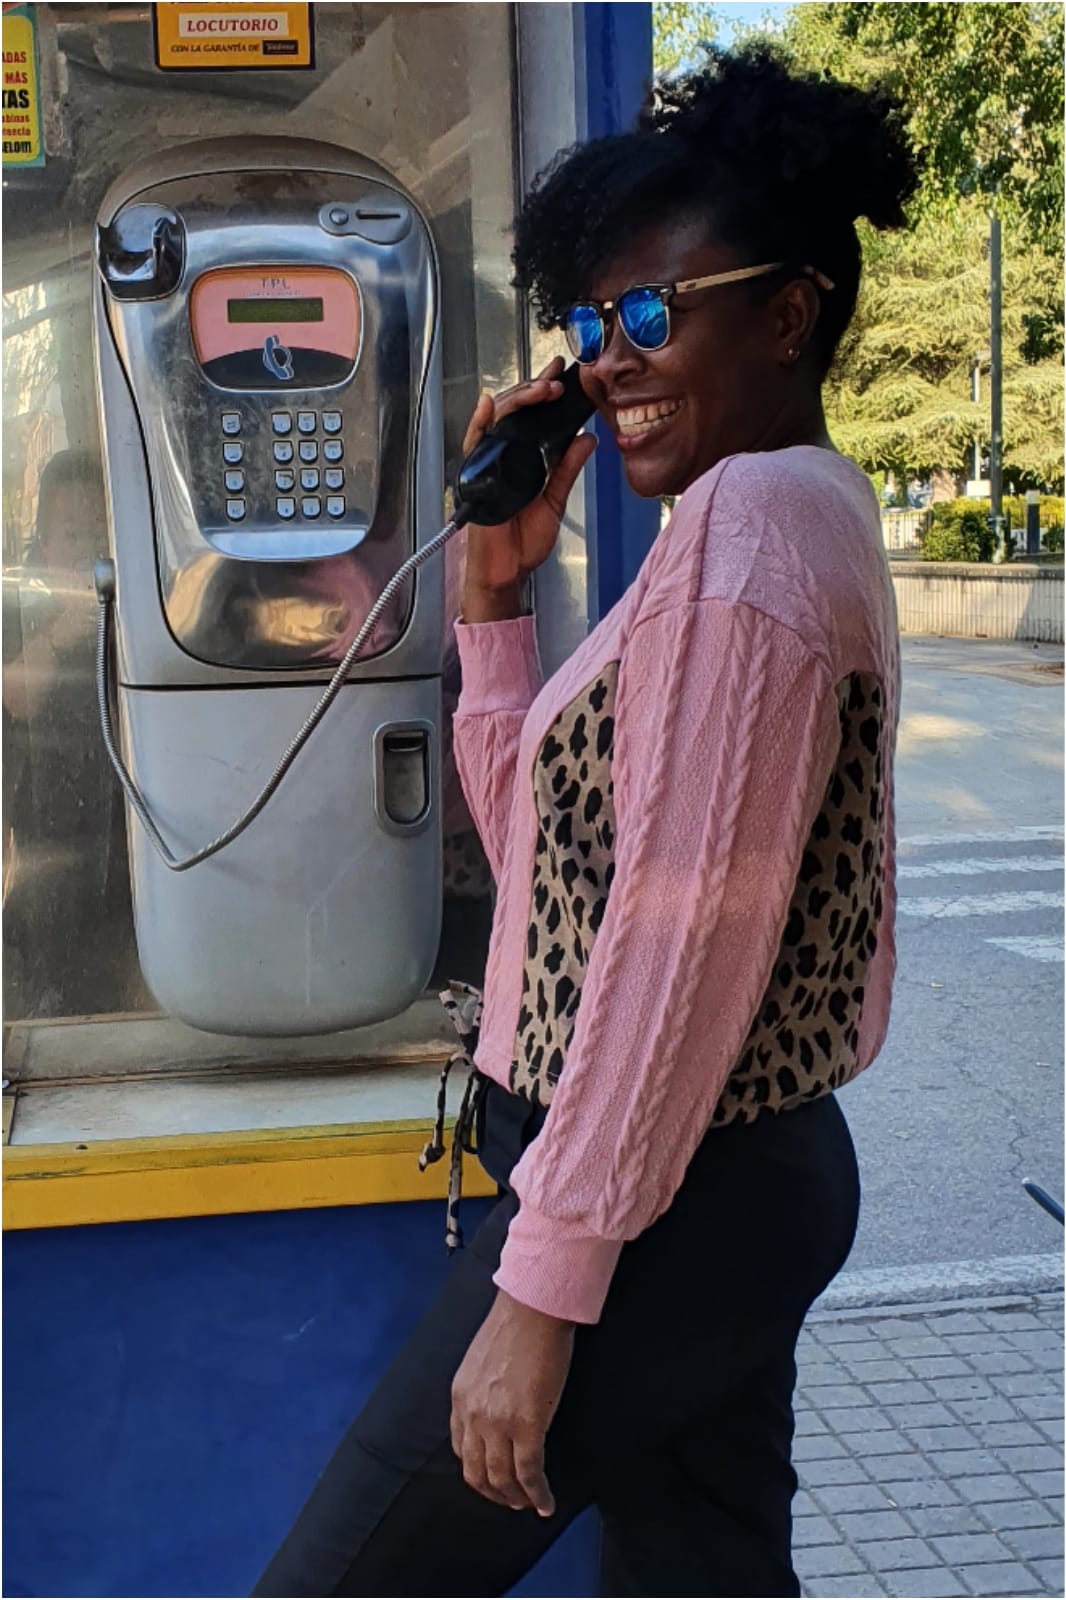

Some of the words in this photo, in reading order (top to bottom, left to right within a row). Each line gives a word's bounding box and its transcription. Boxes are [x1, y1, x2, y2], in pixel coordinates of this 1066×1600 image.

[187, 18, 279, 33] LOCUTORIO
[171, 44, 189, 53] CON
[191, 44, 201, 53] LA
[248, 43, 260, 52] DE
[5, 70, 28, 84] MÁS
